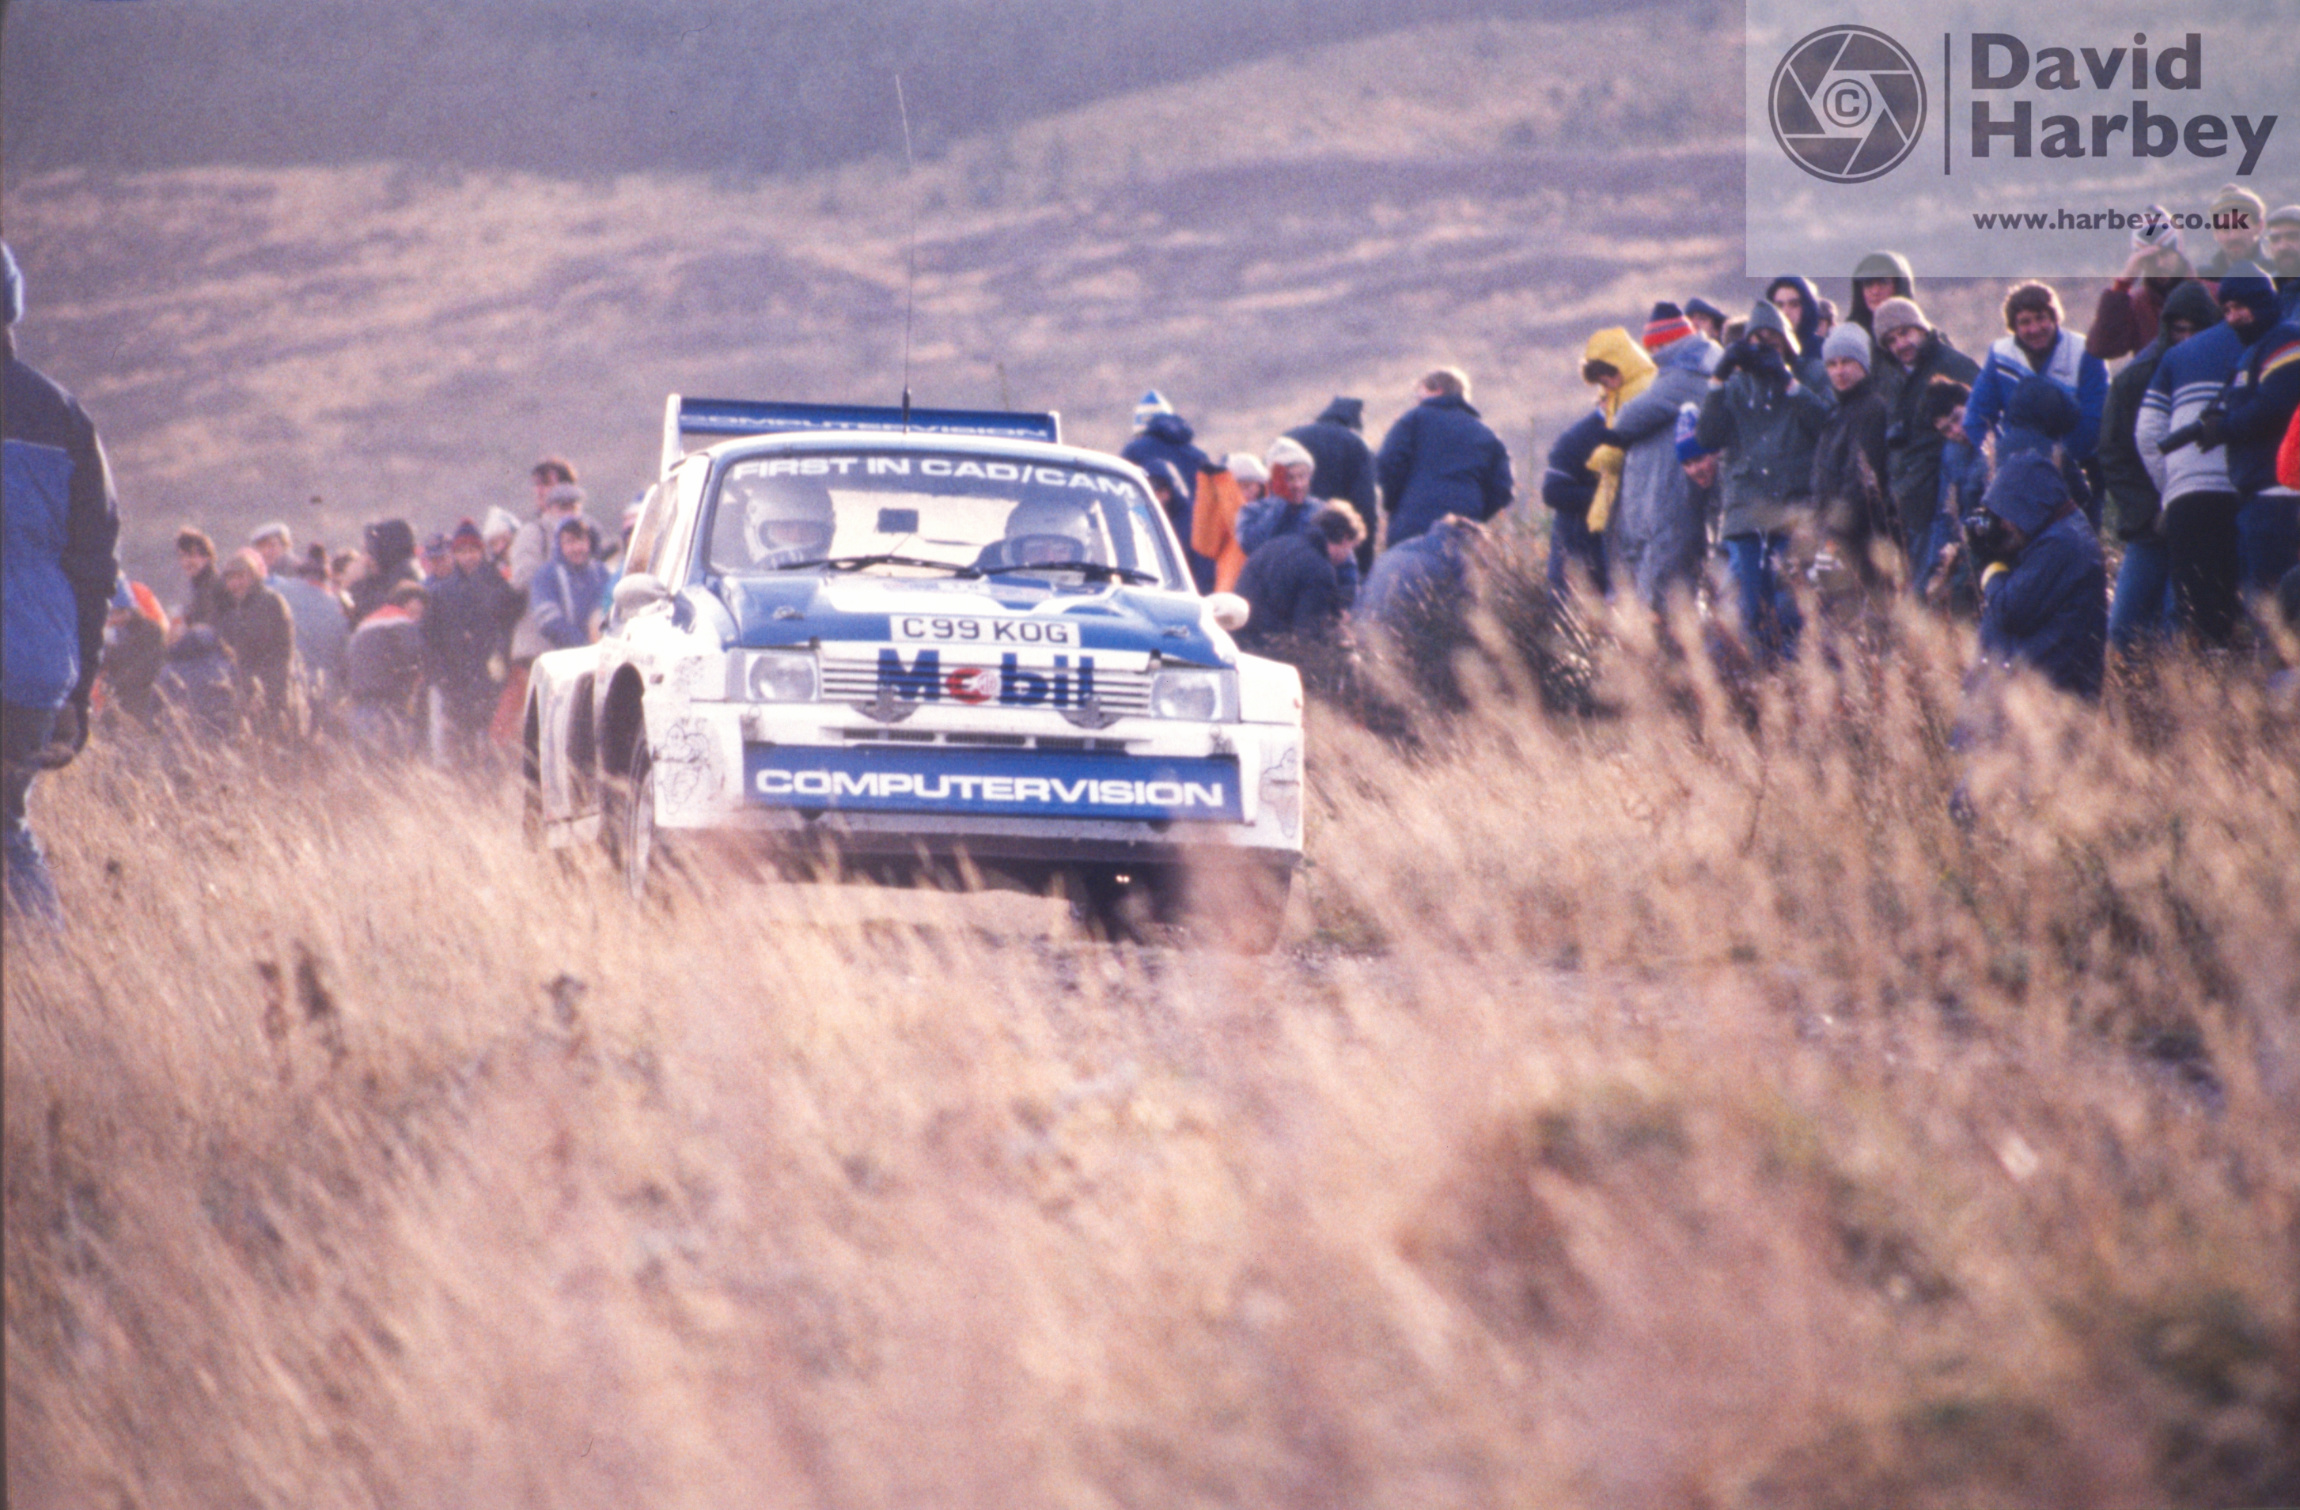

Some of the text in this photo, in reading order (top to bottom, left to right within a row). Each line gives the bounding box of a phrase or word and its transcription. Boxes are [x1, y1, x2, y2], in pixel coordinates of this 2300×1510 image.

[732, 457, 1139, 500] FIRST IN CAD/CAM
[902, 617, 1069, 644] C99 KOG
[755, 768, 1225, 807] COMPUTERVISION
